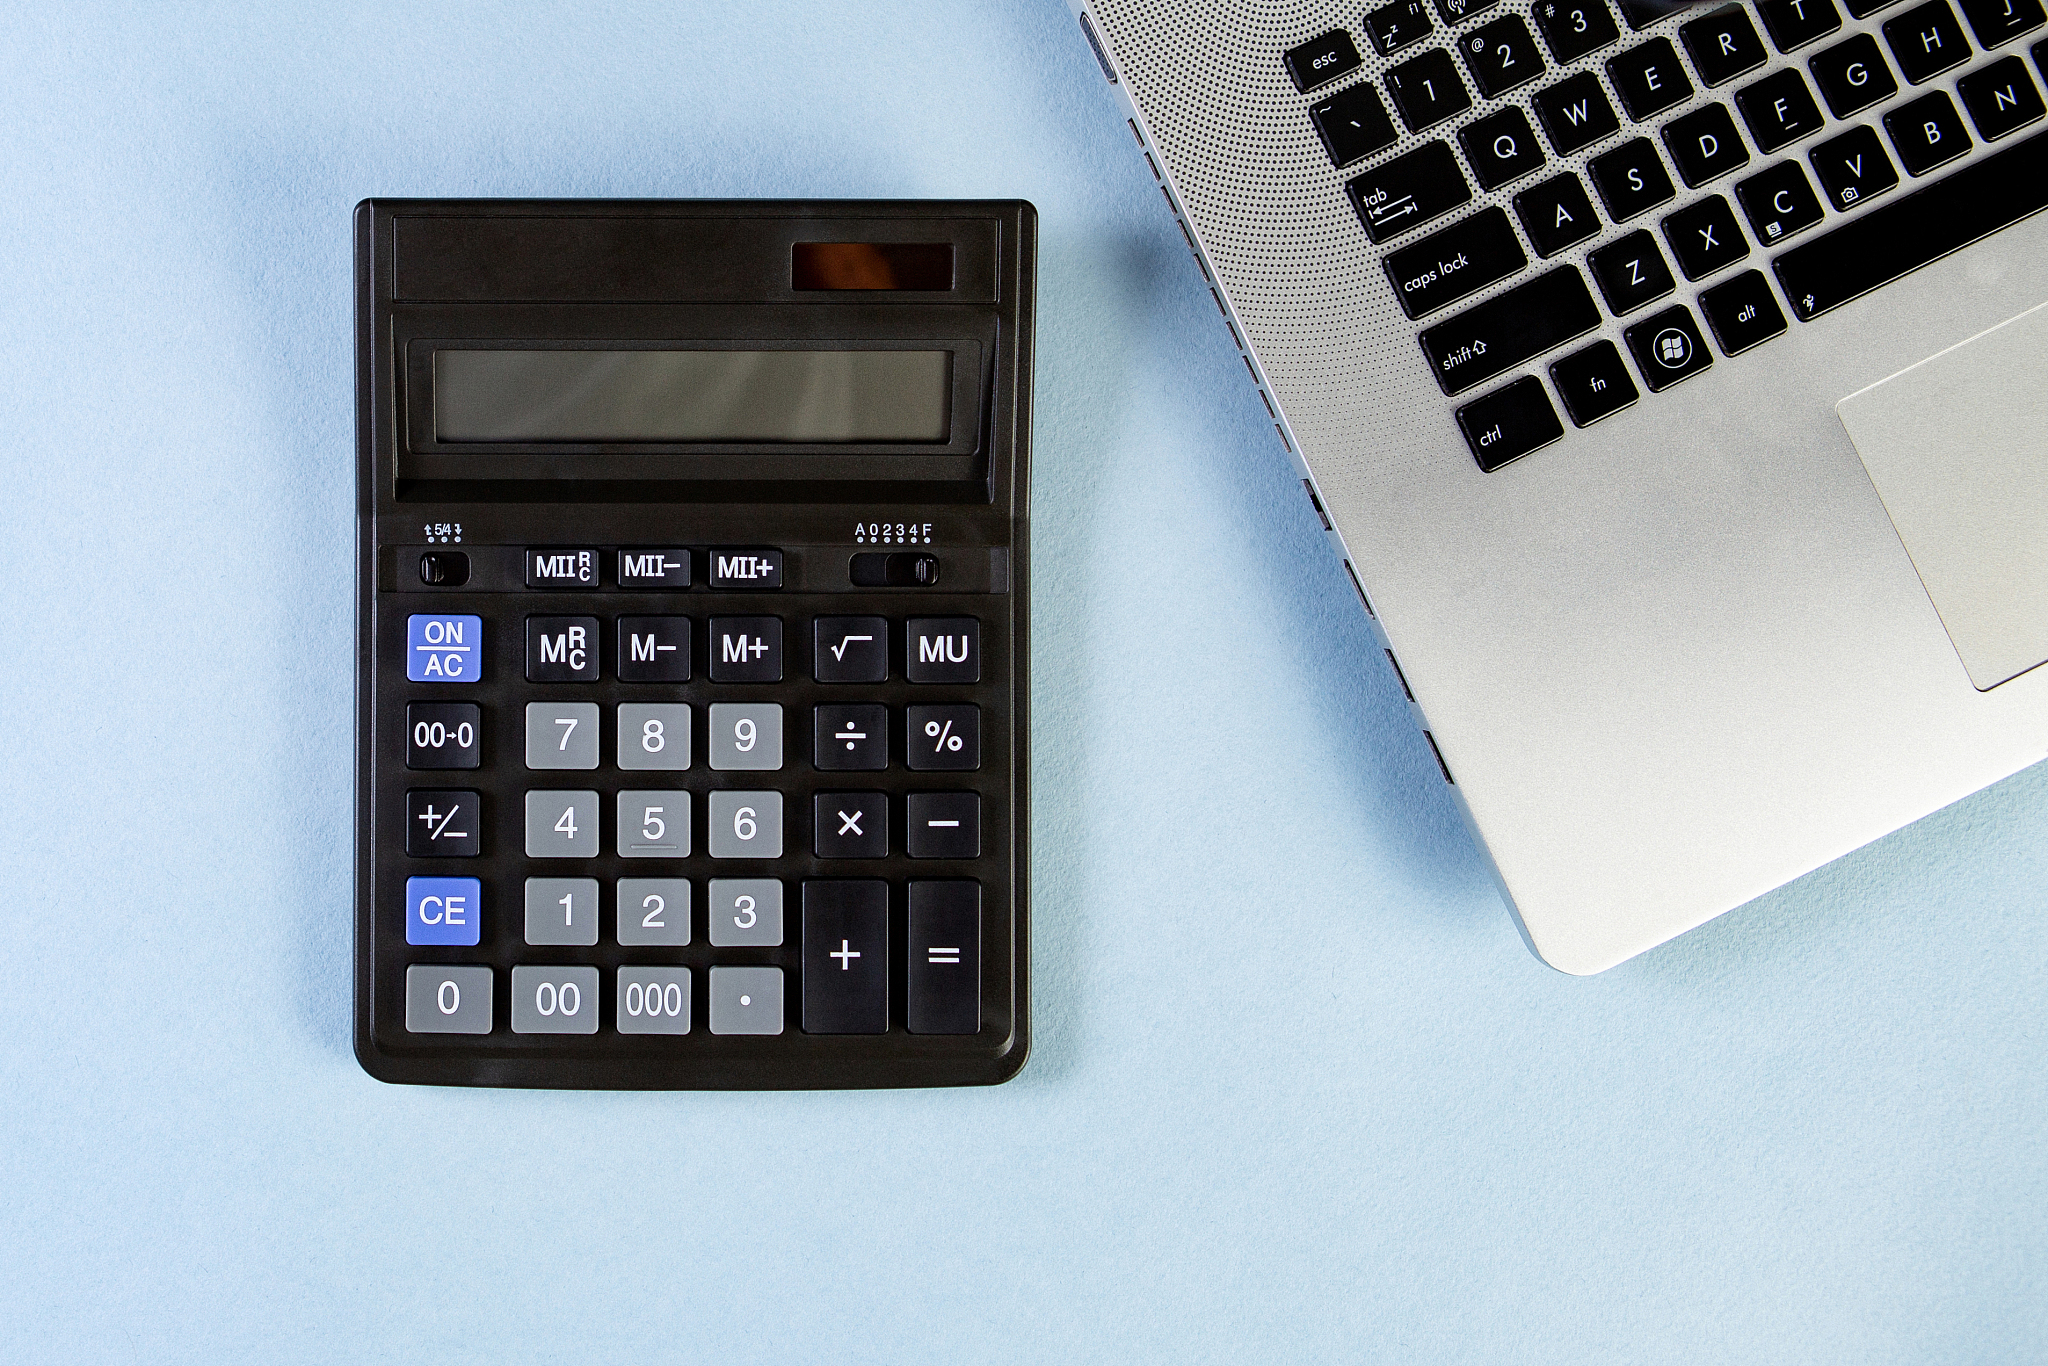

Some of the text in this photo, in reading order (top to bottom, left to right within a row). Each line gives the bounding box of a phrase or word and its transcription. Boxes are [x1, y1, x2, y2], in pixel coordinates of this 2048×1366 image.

[1409, 2, 1419, 15] f1
[1545, 4, 1554, 18] #
[1790, 0, 1805, 21] T
[1571, 10, 1586, 32] 3
[1472, 38, 1483, 52] @
[1718, 33, 1736, 55] R
[1921, 27, 1941, 52] H
[1313, 52, 1336, 69] esc
[1497, 45, 1514, 68] 2
[1394, 75, 1402, 89] !
[1645, 67, 1661, 90] E
[1847, 63, 1867, 85] G
[1423, 80, 1435, 101] 1
[1995, 85, 2016, 110] N
[1563, 99, 1586, 126] W
[1774, 98, 1787, 122] F
[1924, 122, 1940, 144] B
[1494, 136, 1517, 158] Q
[1699, 135, 1717, 158] D
[1846, 154, 1860, 177] V
[1628, 169, 1642, 190] S
[1363, 187, 1387, 207] tab
[1774, 191, 1792, 213] C
[1556, 204, 1573, 227] A
[1699, 225, 1718, 250] X
[1405, 253, 1468, 291] caps lock
[1626, 260, 1645, 285] Z
[1739, 305, 1755, 322] alt
[1444, 347, 1471, 370] shift
[1591, 378, 1606, 392] fn
[1481, 425, 1501, 446] ctrl
[425, 622, 462, 643] ON
[723, 635, 768, 662] M+
[920, 636, 967, 662] MU
[424, 654, 462, 676] AC
[556, 719, 577, 750] 7
[643, 720, 664, 752] 8
[735, 719, 756, 751] 9
[925, 721, 962, 752] %
[555, 807, 577, 838] 4
[643, 807, 664, 839] 5
[735, 807, 756, 839] 6
[420, 897, 465, 924] CE
[560, 894, 571, 925] 1
[643, 895, 664, 927] 2
[734, 896, 756, 928] 3
[830, 940, 860, 970] +
[929, 948, 959, 962] =
[438, 981, 459, 1014] 0
[537, 983, 580, 1015] 00
[627, 983, 681, 1016] 000
